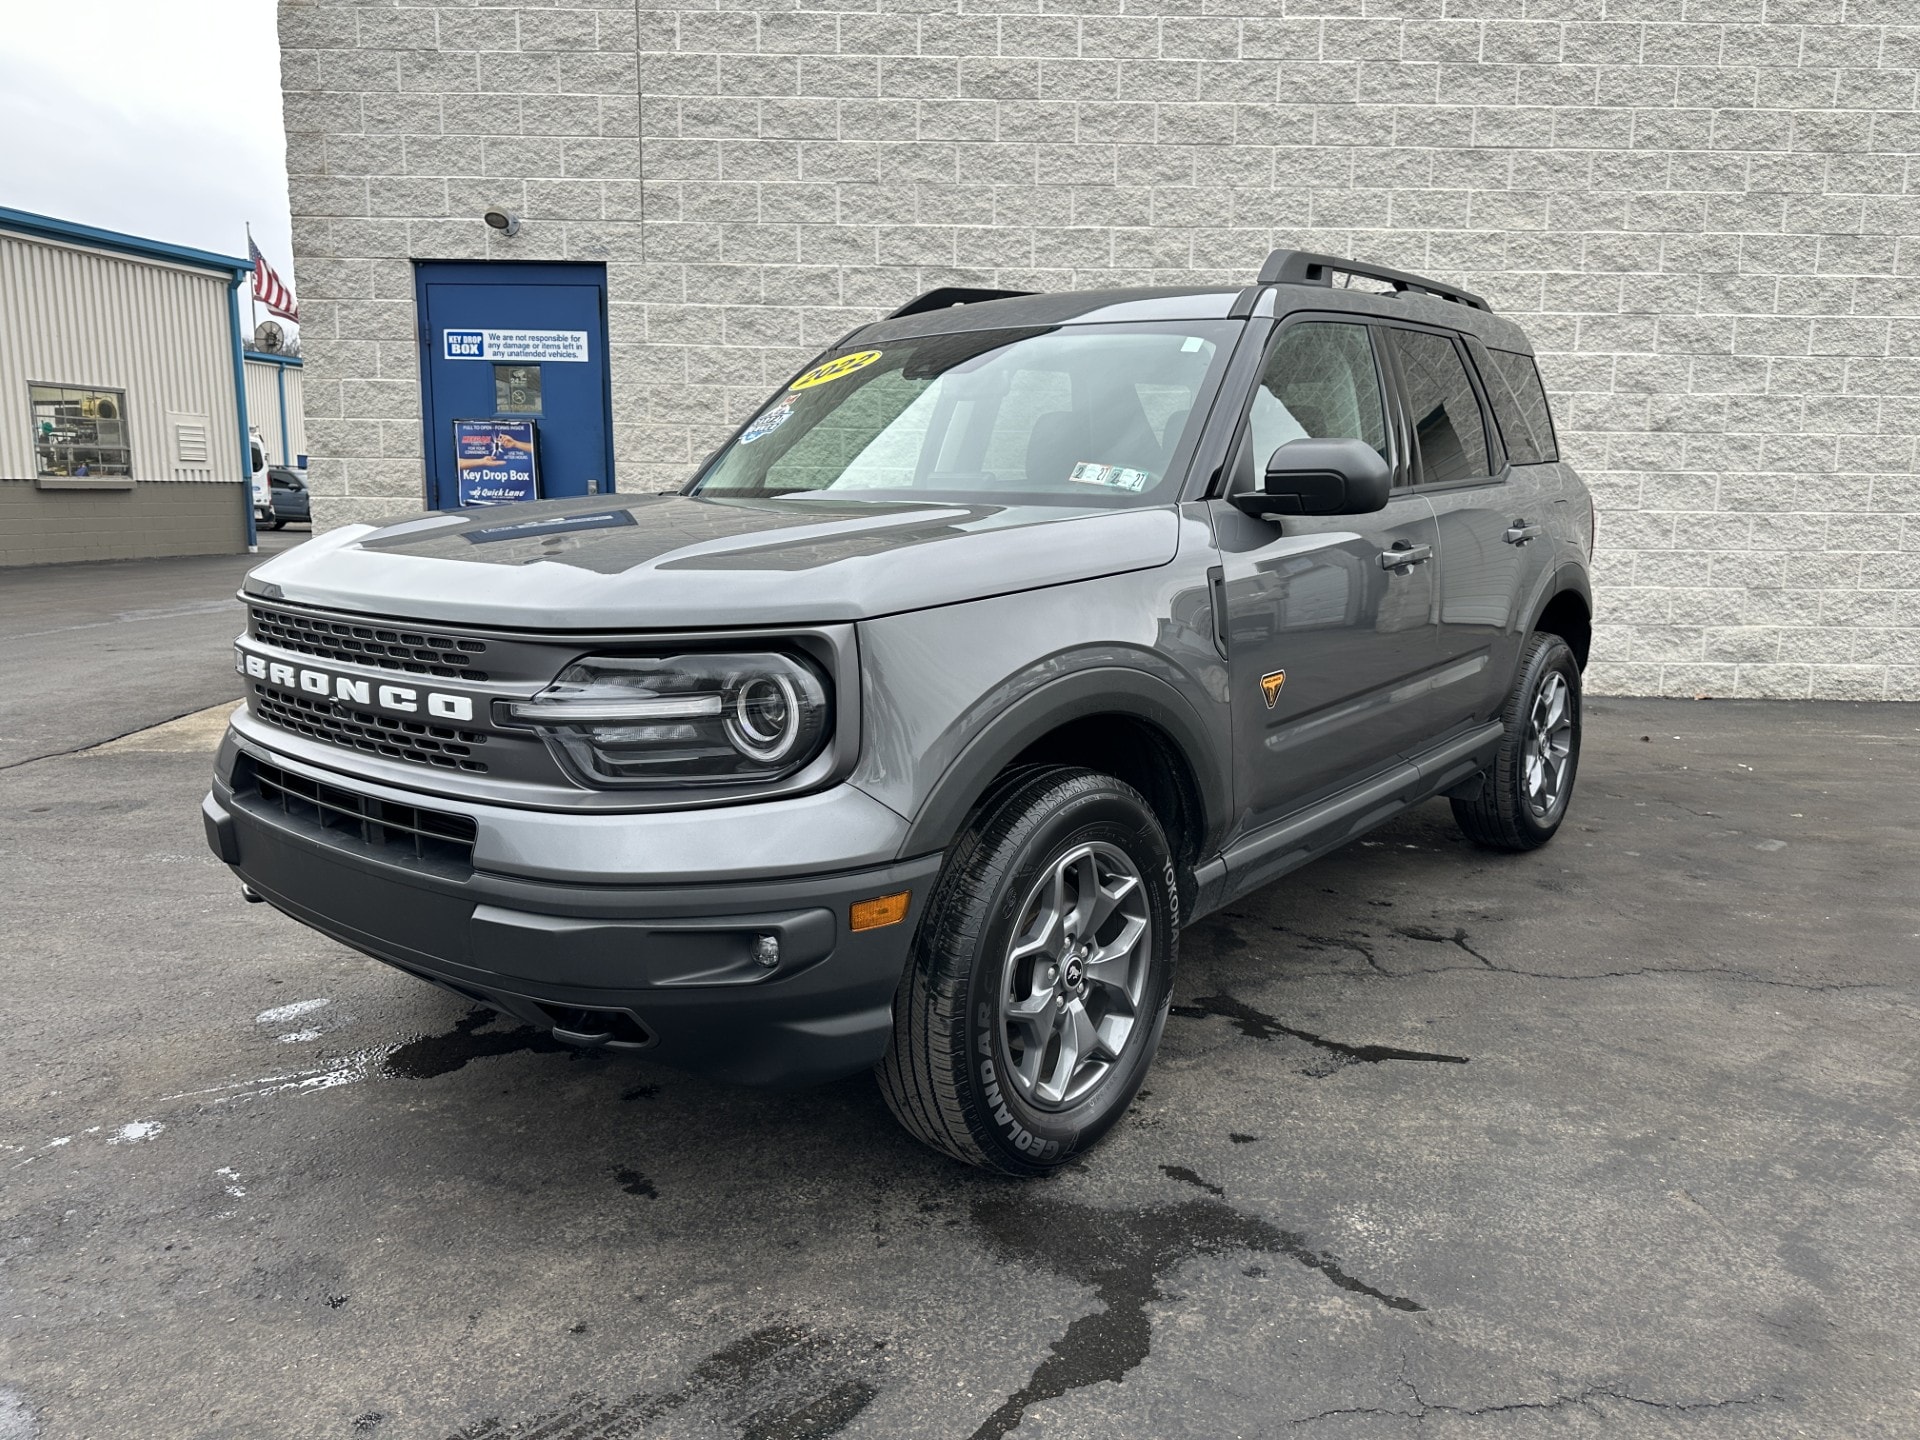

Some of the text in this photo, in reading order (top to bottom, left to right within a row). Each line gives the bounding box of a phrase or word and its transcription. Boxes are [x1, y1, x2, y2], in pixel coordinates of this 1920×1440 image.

[448, 336, 482, 344] KEY DROP
[488, 333, 501, 341] We
[528, 334, 569, 344] responsible
[451, 344, 480, 355] BOX
[503, 342, 531, 350] damage
[492, 350, 579, 359] any unattended vehicles.
[796, 352, 876, 388] 2022
[463, 470, 530, 482] Key Drop Box
[1074, 467, 1084, 479] 2
[1110, 472, 1145, 487] 2 27
[481, 488, 525, 497] Quick Lane
[246, 654, 473, 722] BRONCO
[977, 1001, 1060, 1160] GEOLANDAR
